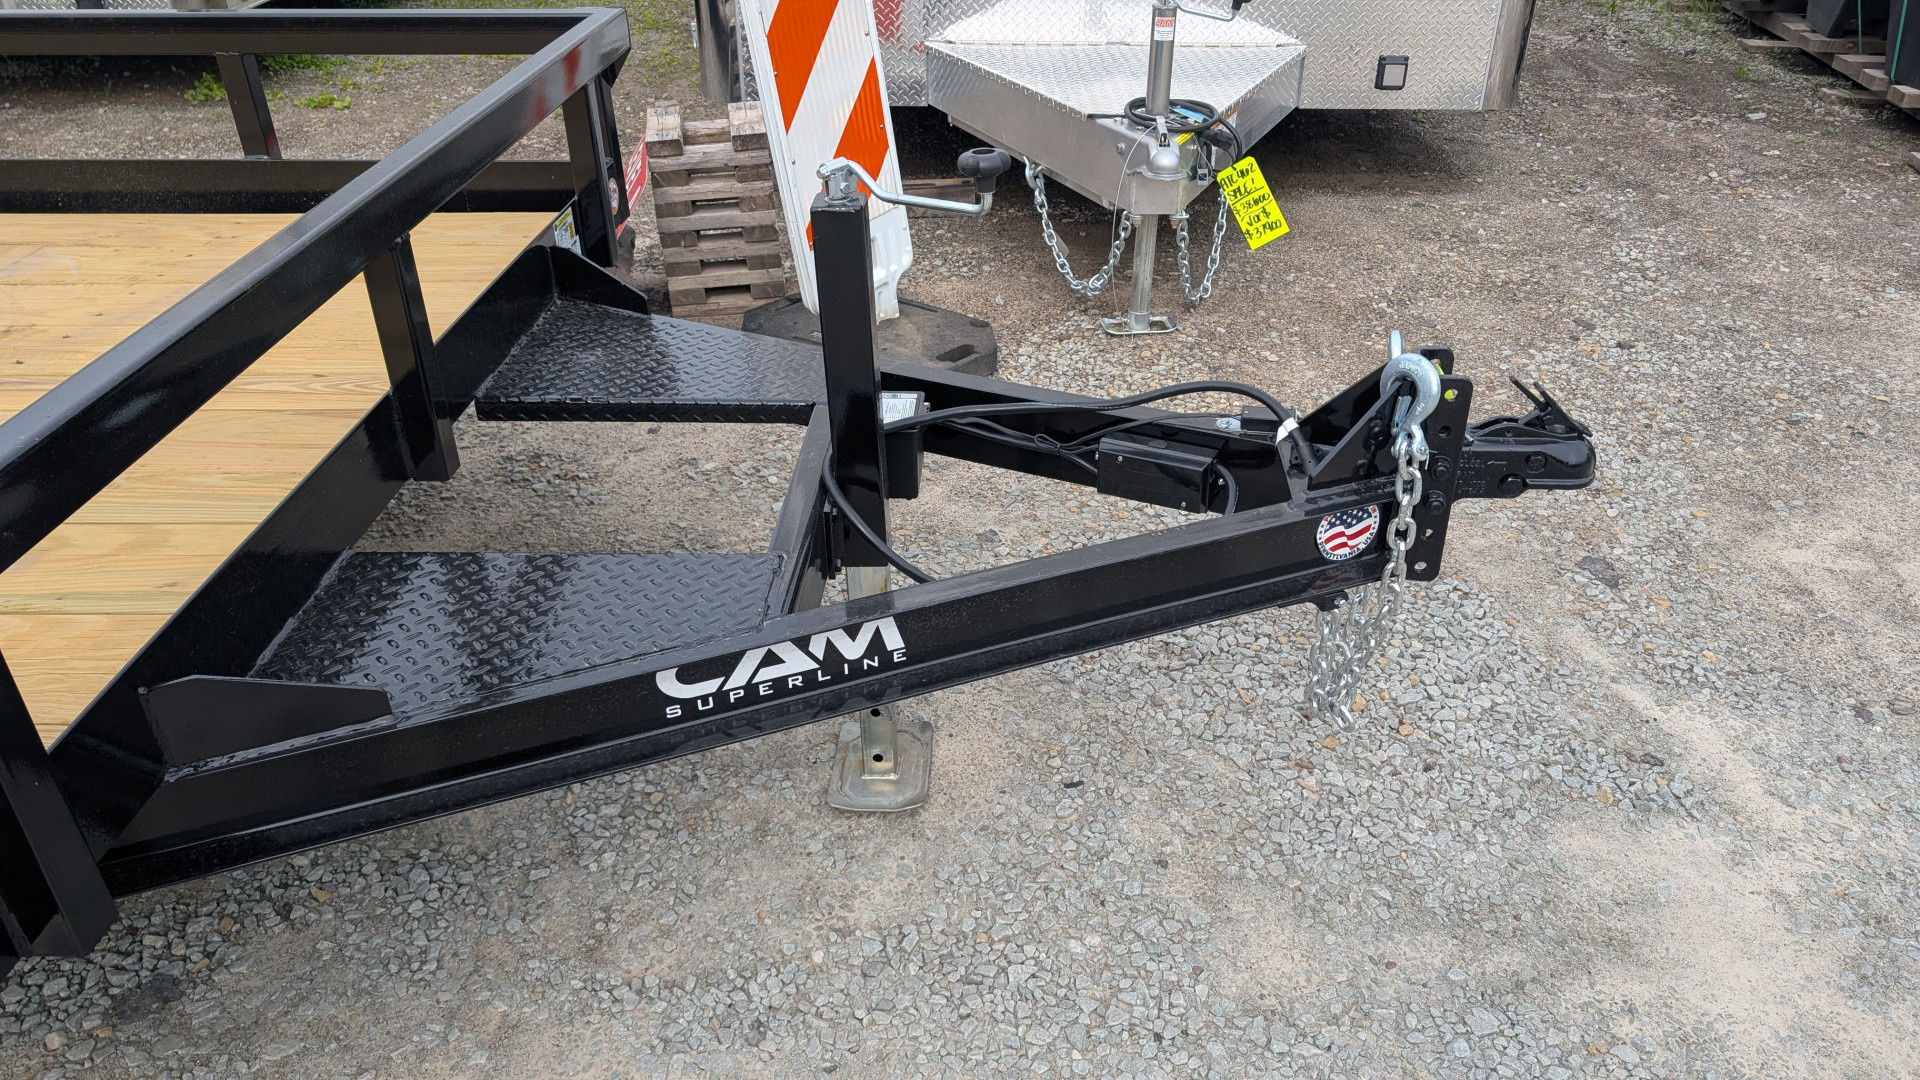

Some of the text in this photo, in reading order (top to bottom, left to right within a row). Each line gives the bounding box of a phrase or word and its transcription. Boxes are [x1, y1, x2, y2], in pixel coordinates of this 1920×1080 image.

[1156, 18, 1174, 27] RAM
[1362, 531, 1376, 546] USA
[655, 616, 906, 699] CAM
[666, 648, 907, 719] SUPERLINE
